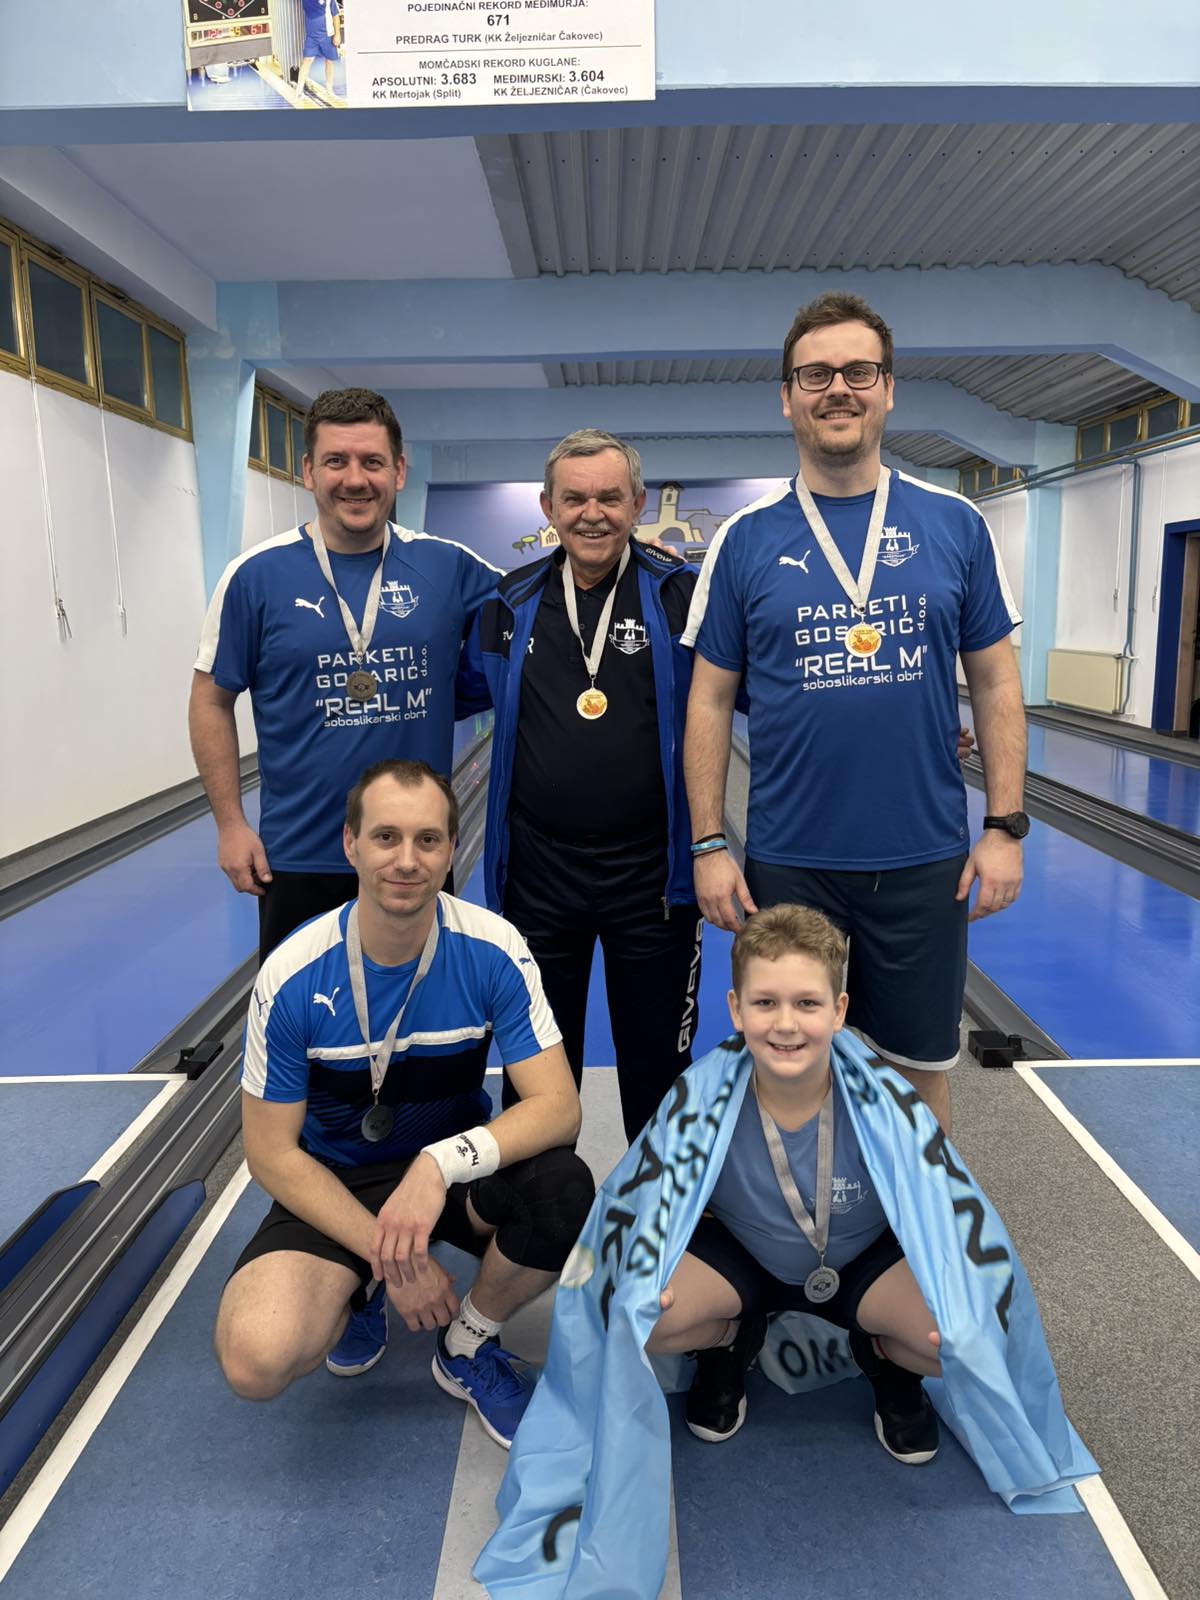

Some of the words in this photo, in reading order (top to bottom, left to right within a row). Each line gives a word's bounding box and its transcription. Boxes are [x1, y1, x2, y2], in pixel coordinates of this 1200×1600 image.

[407, 1, 476, 12] POJEDINAČNI
[478, 1, 522, 10] REKORD
[487, 14, 510, 26] 671
[395, 34, 449, 45] PREDRAG
[452, 33, 482, 43] TURK
[484, 33, 502, 44] (KK
[504, 31, 556, 43] Željezničar
[558, 30, 603, 41] Čakovec)
[419, 59, 481, 69] MOMČADSKI
[483, 58, 526, 68] REKORD
[528, 57, 581, 67] KUGLANE:
[372, 76, 437, 86] APSOLUTNI:
[441, 73, 477, 85] 3.683
[569, 70, 604, 82] 3.604
[372, 90, 387, 99] KK
[389, 89, 431, 100] Mertojak
[432, 89, 462, 99] (Split)
[493, 88, 508, 96] KK
[510, 85, 579, 96] ŽELJEZNIČAR
[580, 84, 628, 95] (Čakovec)
[797, 595, 907, 623] PARKETI
[795, 611, 914, 646] GOSRIĆ
[316, 662, 418, 689] GOARIĆ
[802, 672, 893, 691] soboslikarski
[896, 670, 924, 682] obrt
[323, 711, 401, 728] soboslikarski
[404, 710, 428, 721] obrt
